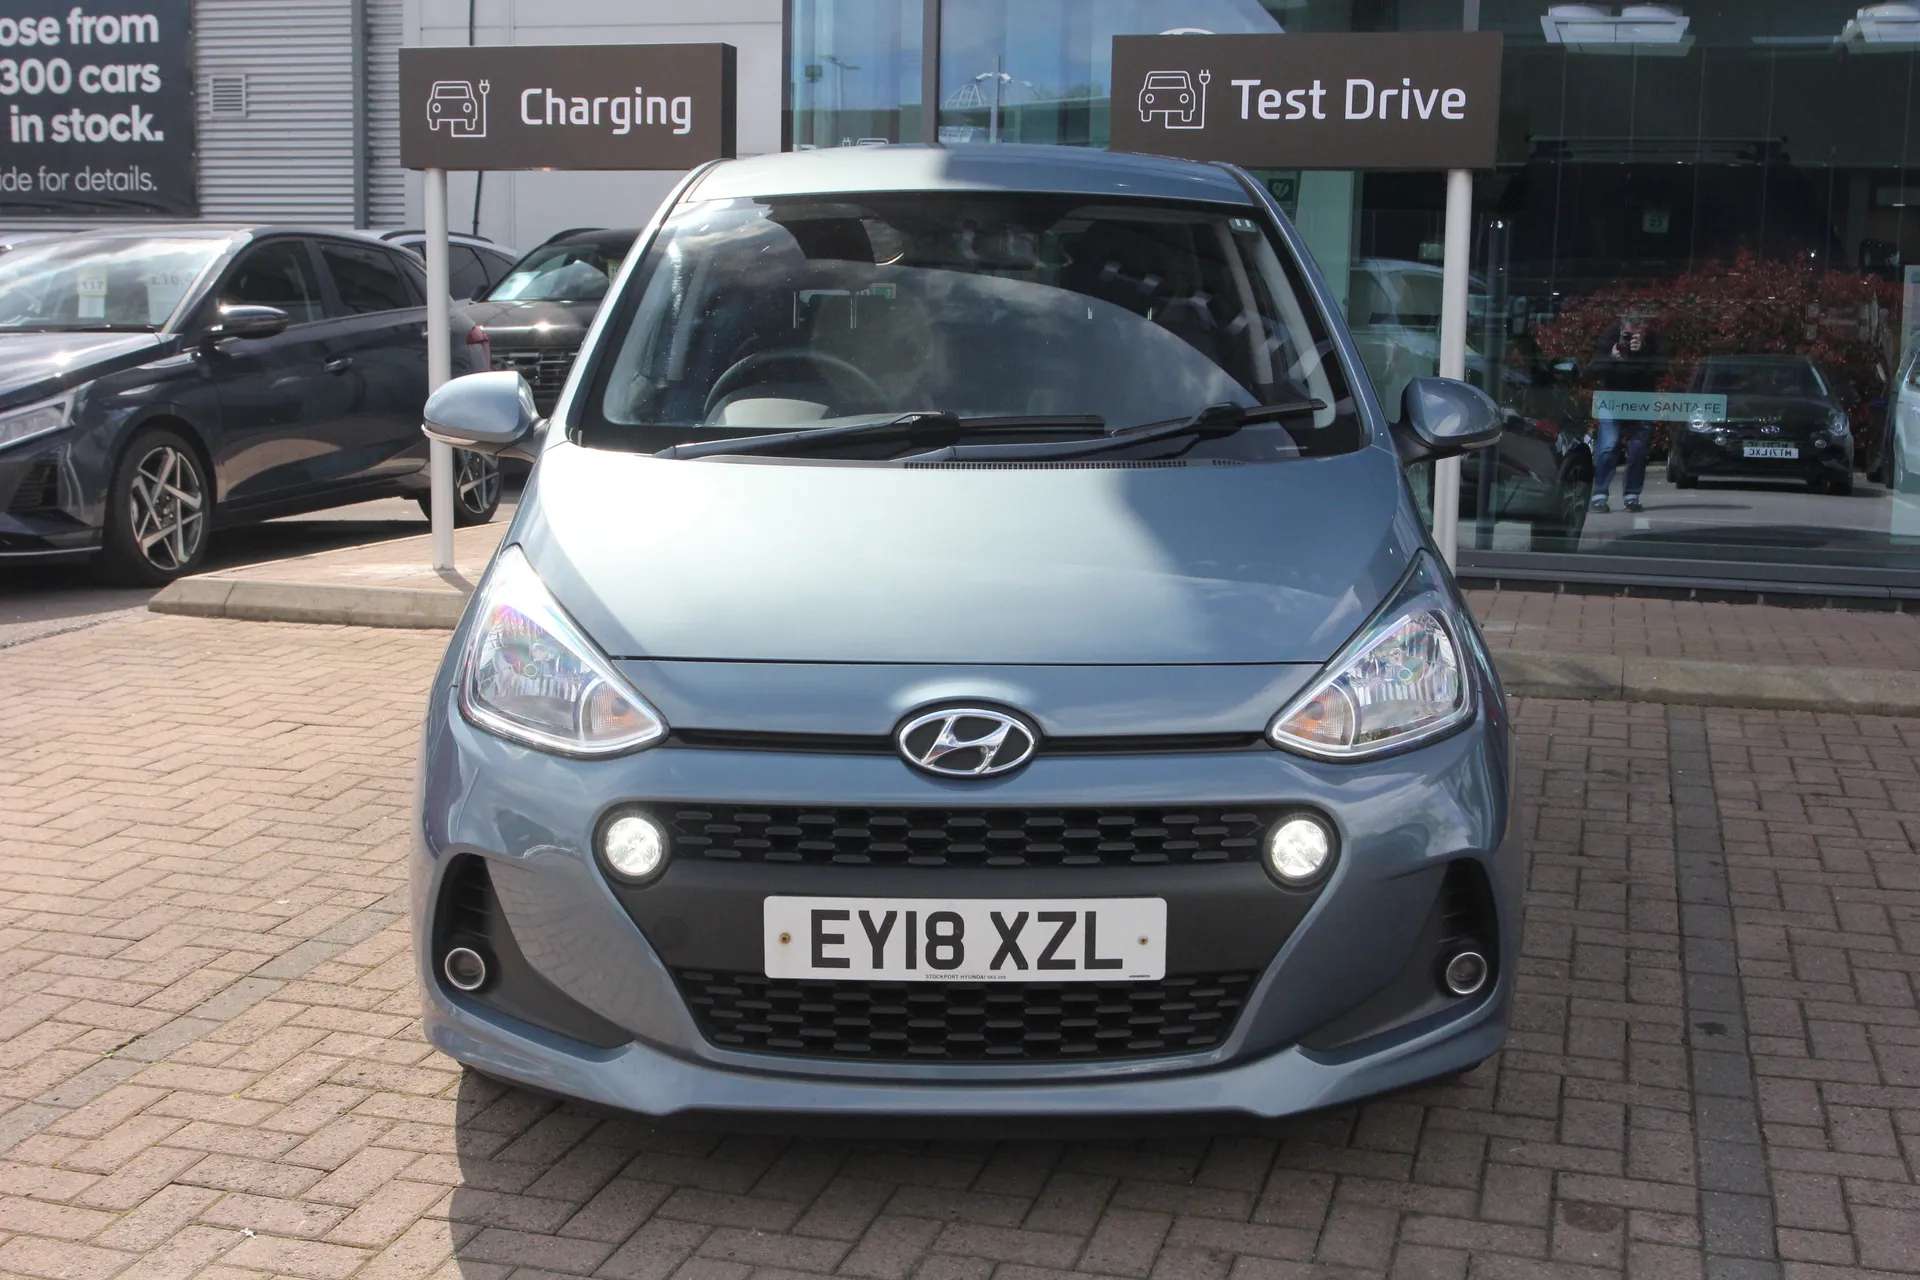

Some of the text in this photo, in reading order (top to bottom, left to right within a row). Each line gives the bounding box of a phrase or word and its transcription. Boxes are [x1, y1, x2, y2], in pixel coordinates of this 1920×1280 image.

[0, 6, 160, 47] ose from
[0, 57, 162, 96] 300 cars
[519, 86, 693, 135] Charging
[1230, 77, 1467, 121] Test Drive
[9, 104, 165, 143] in stock.
[38, 165, 70, 192] for
[74, 164, 158, 192] details.
[1598, 399, 1722, 415] All-new SANTA FE
[810, 909, 1124, 970] EY18 XZL
